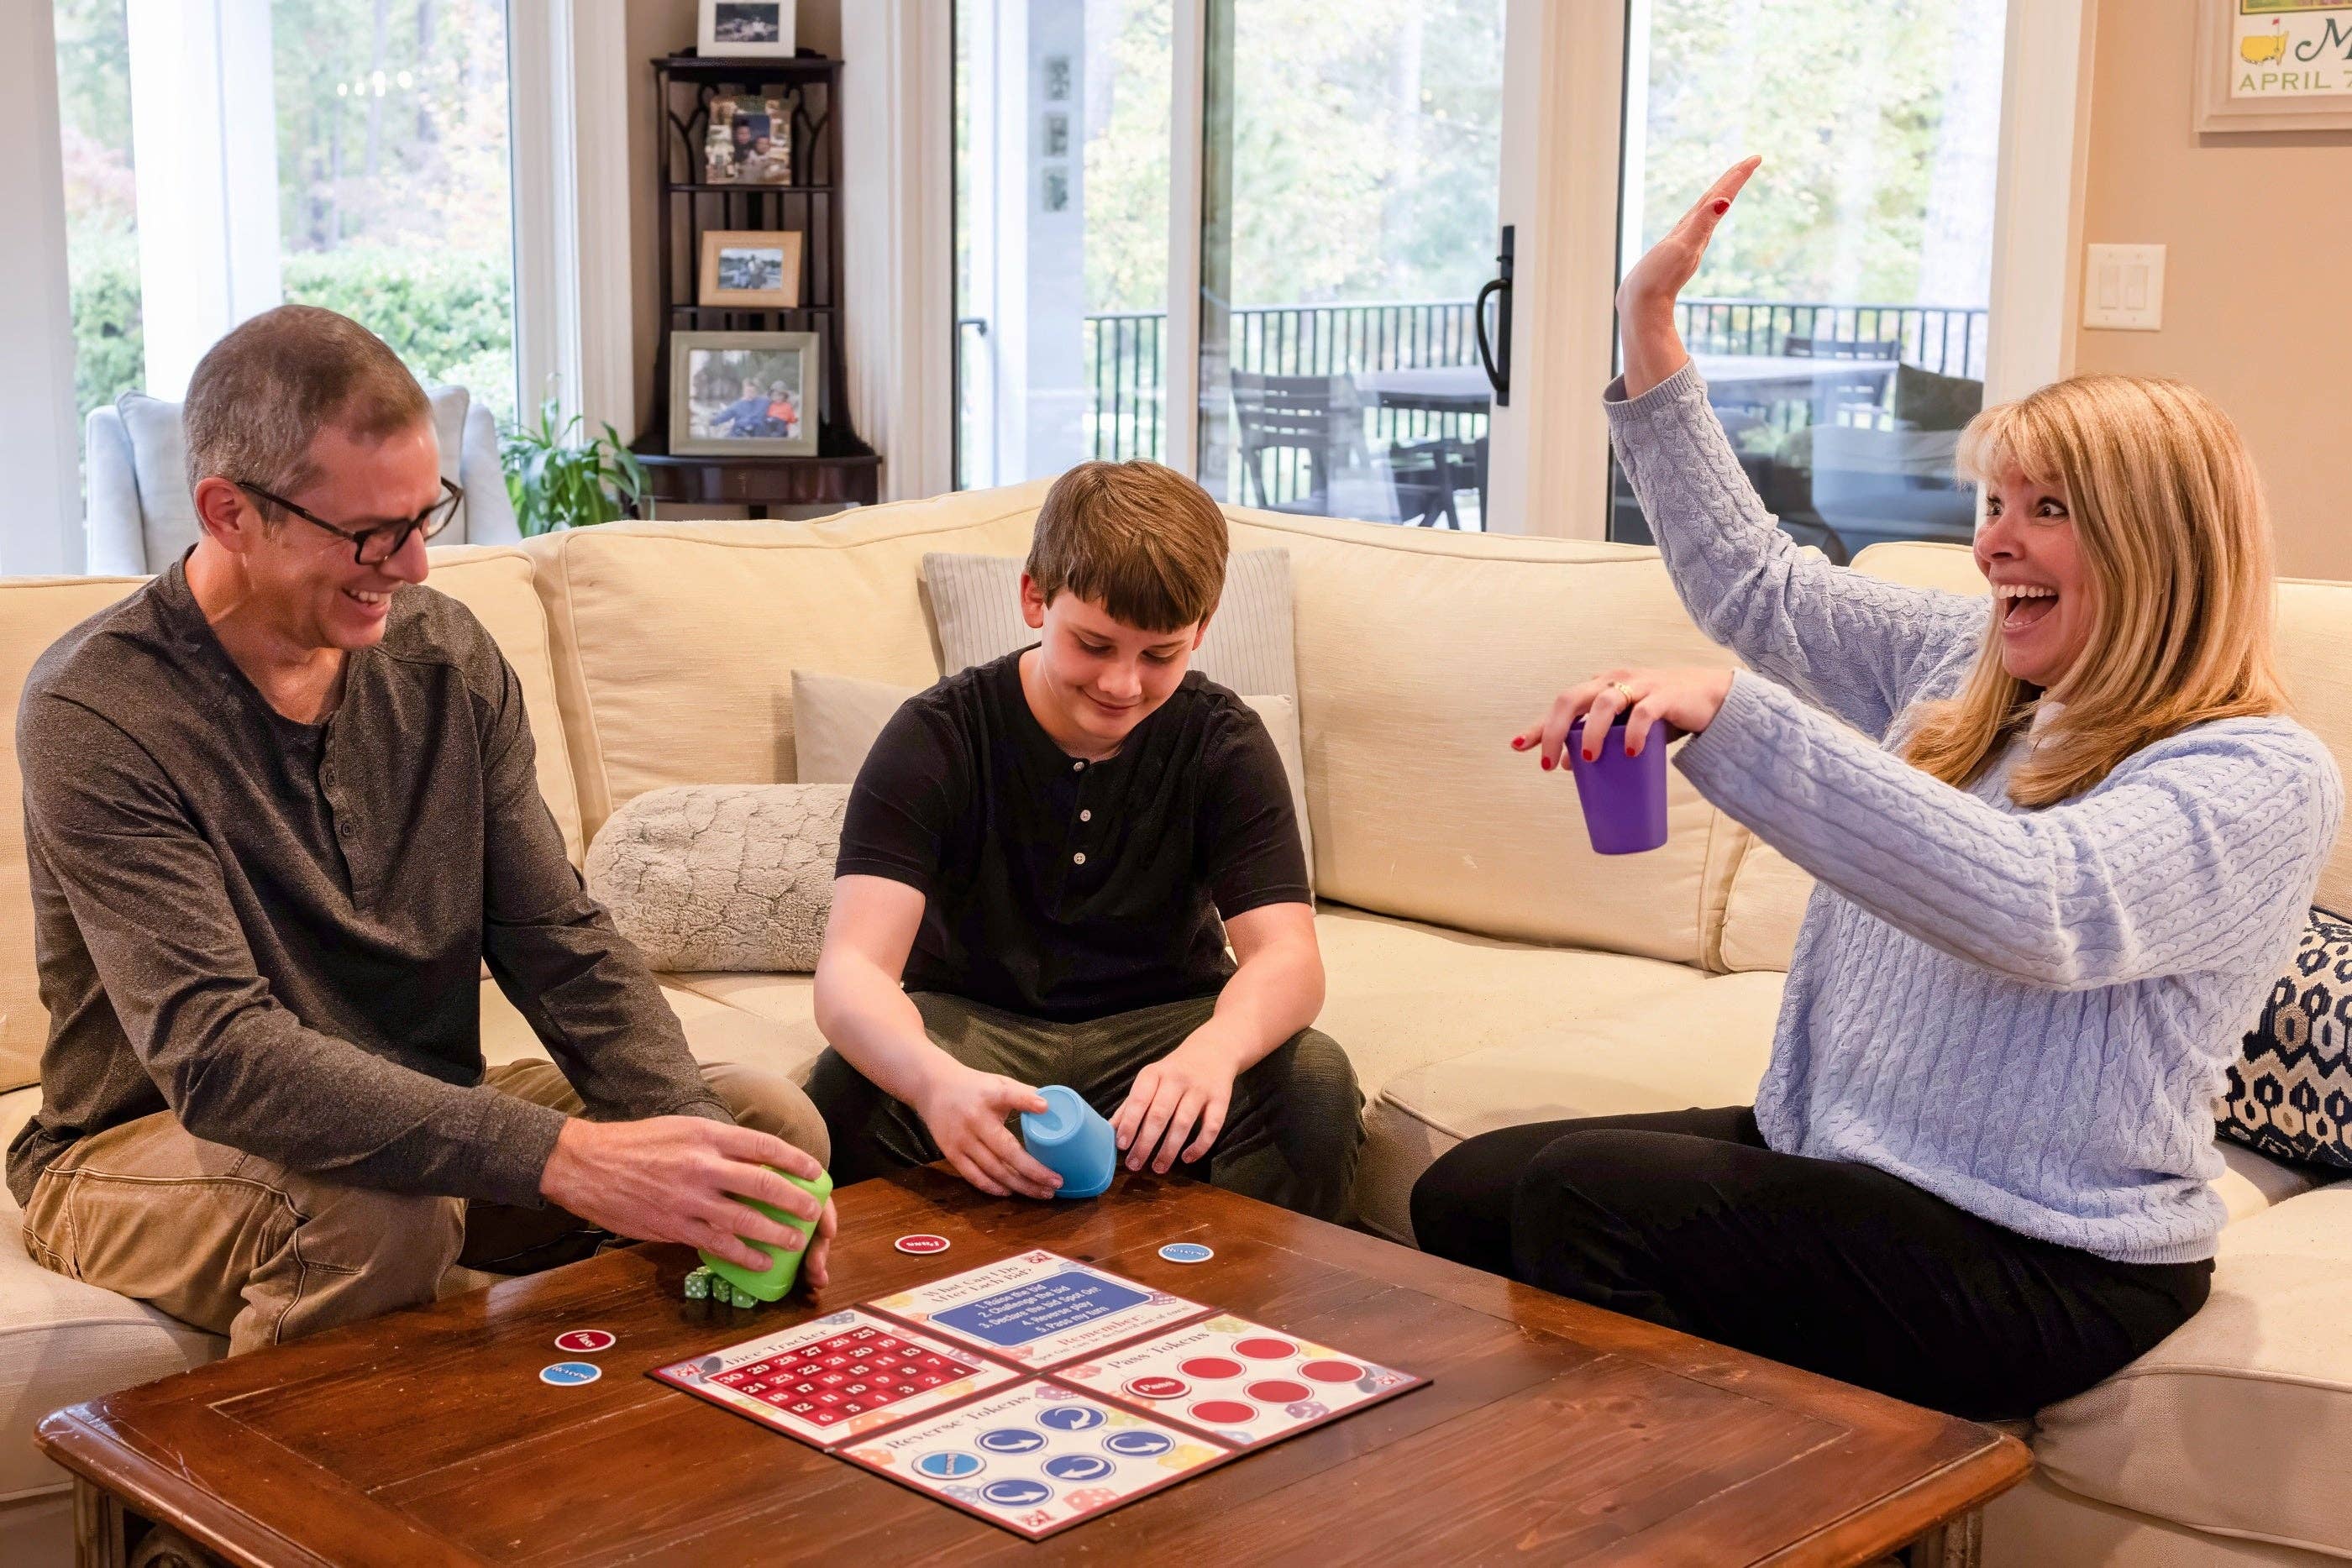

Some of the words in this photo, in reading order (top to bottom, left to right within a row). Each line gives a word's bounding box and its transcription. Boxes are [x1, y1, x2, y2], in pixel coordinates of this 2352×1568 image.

[2239, 71, 2332, 91] APRIL
[988, 1297, 1037, 1314] Challenge
[1034, 1291, 1054, 1299] the
[1050, 1285, 1070, 1294] bid
[719, 1373, 743, 1383] 30
[747, 1364, 769, 1374] 29
[801, 1345, 821, 1356] 27
[853, 1329, 875, 1339] 25
[725, 1350, 764, 1366] Dice
[764, 1329, 827, 1351] Tracker
[769, 1373, 793, 1383] 23
[797, 1364, 822, 1374] 22
[826, 1356, 845, 1365] 21
[849, 1347, 873, 1356] 20
[878, 1339, 895, 1347] 19
[1107, 1354, 1150, 1369] Pass
[1147, 1332, 1210, 1354] Tokens
[795, 1383, 813, 1392] 17
[849, 1365, 869, 1374] 15
[901, 1347, 921, 1356] 13
[1139, 1380, 1176, 1392] Pass
[791, 1403, 813, 1412] 12
[821, 1393, 837, 1402] 11
[846, 1384, 866, 1393] 10
[846, 1403, 860, 1412] 5
[885, 1419, 963, 1449] Reverse
[962, 1396, 1031, 1420] Tokens
